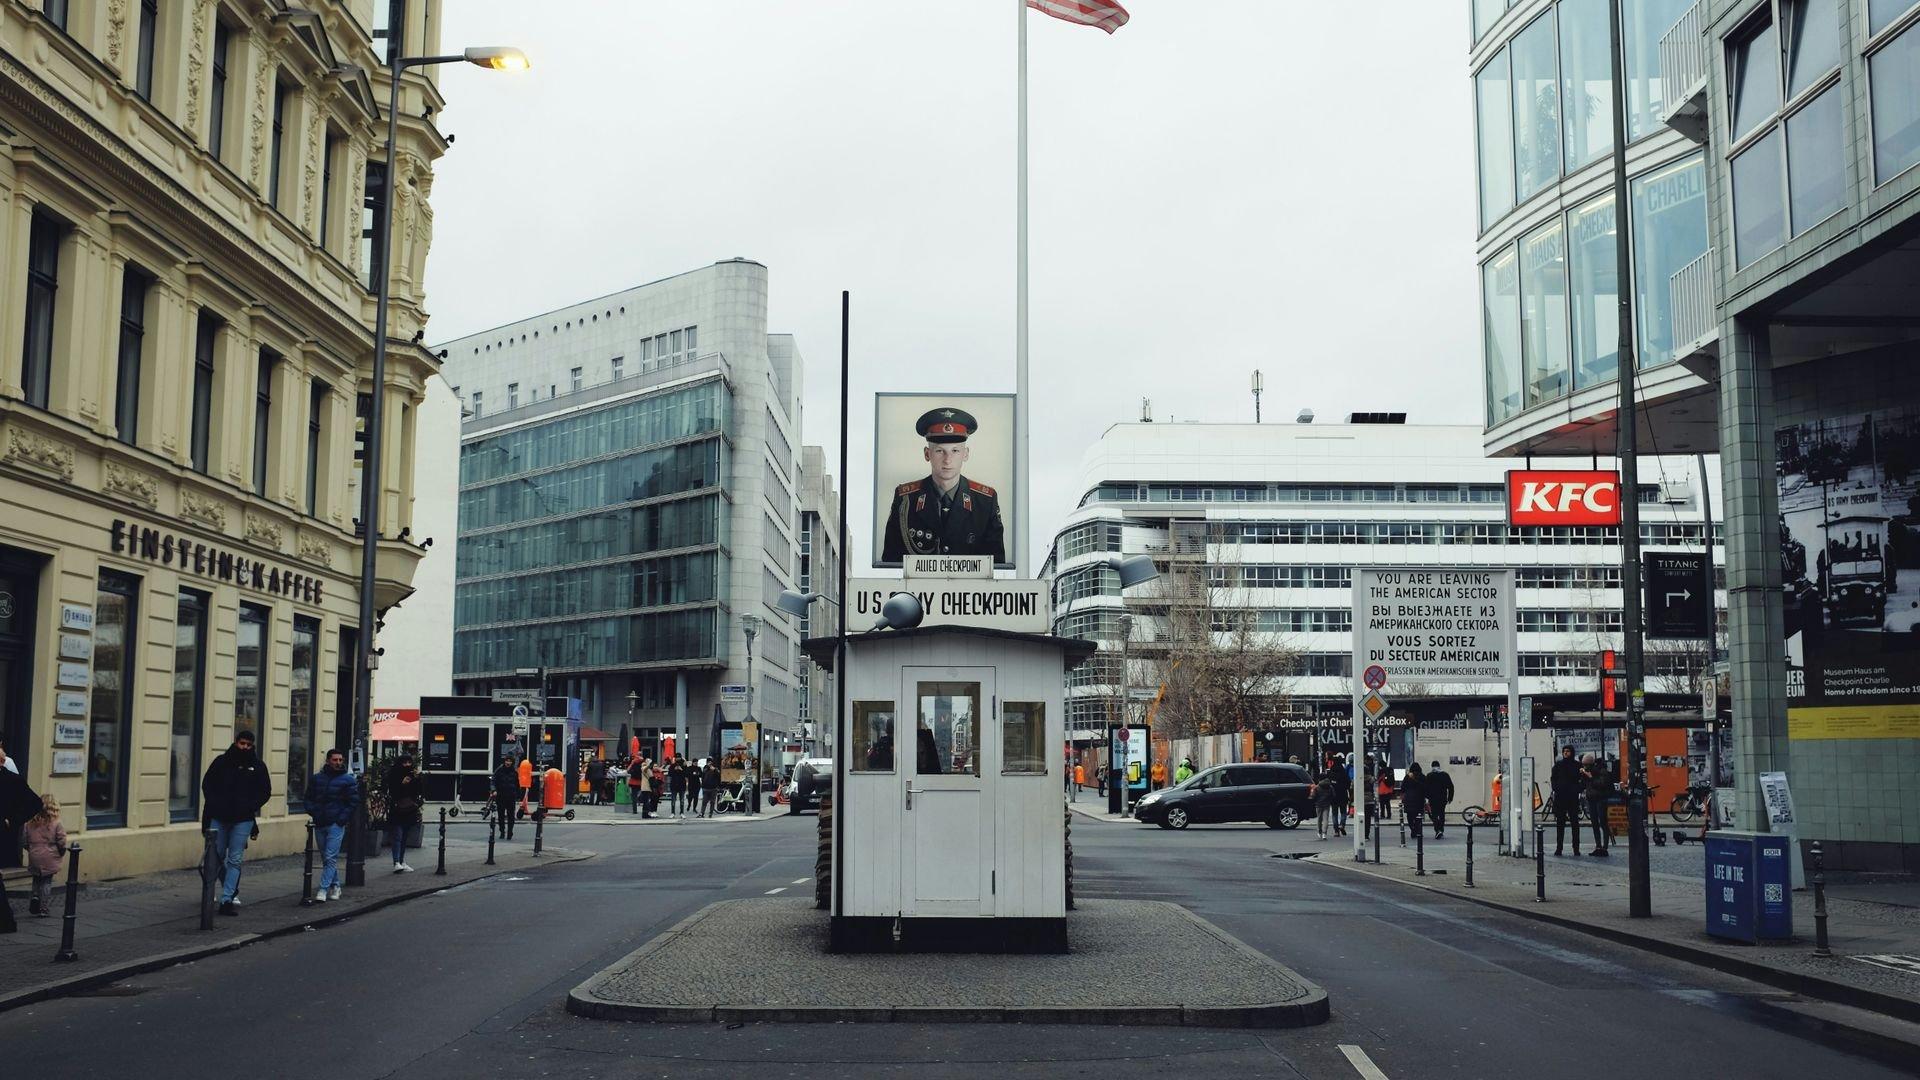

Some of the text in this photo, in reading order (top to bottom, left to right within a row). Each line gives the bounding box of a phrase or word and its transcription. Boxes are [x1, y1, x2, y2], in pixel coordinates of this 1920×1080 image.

[1648, 166, 1705, 212] CHARLI
[1515, 482, 1615, 512] KFC
[111, 519, 323, 605] EINSTEIN KAFFEE
[915, 559, 982, 573] ALLIED CHECKPOINT
[1658, 560, 1699, 568] TITANIC
[1376, 573, 1491, 586] YOU ARE LEAVING
[1370, 587, 1498, 599] THE AMERICAN SECTOR
[941, 592, 1039, 616] CHECKPOINT
[72, 611, 92, 624] SHIELD
[1372, 605, 1496, 617] ВЫ ВЫЕЗЖАЕТЕ ИЗ
[1369, 618, 1500, 631] АМЕРИКАНСКОГО СЕКТОРА
[1387, 635, 1476, 648] VOUS SORTEZ
[1370, 648, 1500, 662] DU SECTEUR AMÉRICAIN
[1385, 667, 1500, 676] ERLASSEN DEN AMERIKANISCHEN SEKTOR
[1823, 668, 1853, 676] Museum
[1854, 667, 1872, 675] Haus
[1824, 676, 1890, 686] Checkpoint Charlie
[1786, 685, 1805, 697] EUM
[1856, 687, 1889, 695] Freedom
[1890, 686, 1910, 694] since
[1912, 685, 1920, 693] 19
[1330, 717, 1354, 728] Charl
[1365, 716, 1407, 726] BckBox
[1714, 863, 1744, 883] LIFE IN THE
[1723, 886, 1735, 903] GDR
